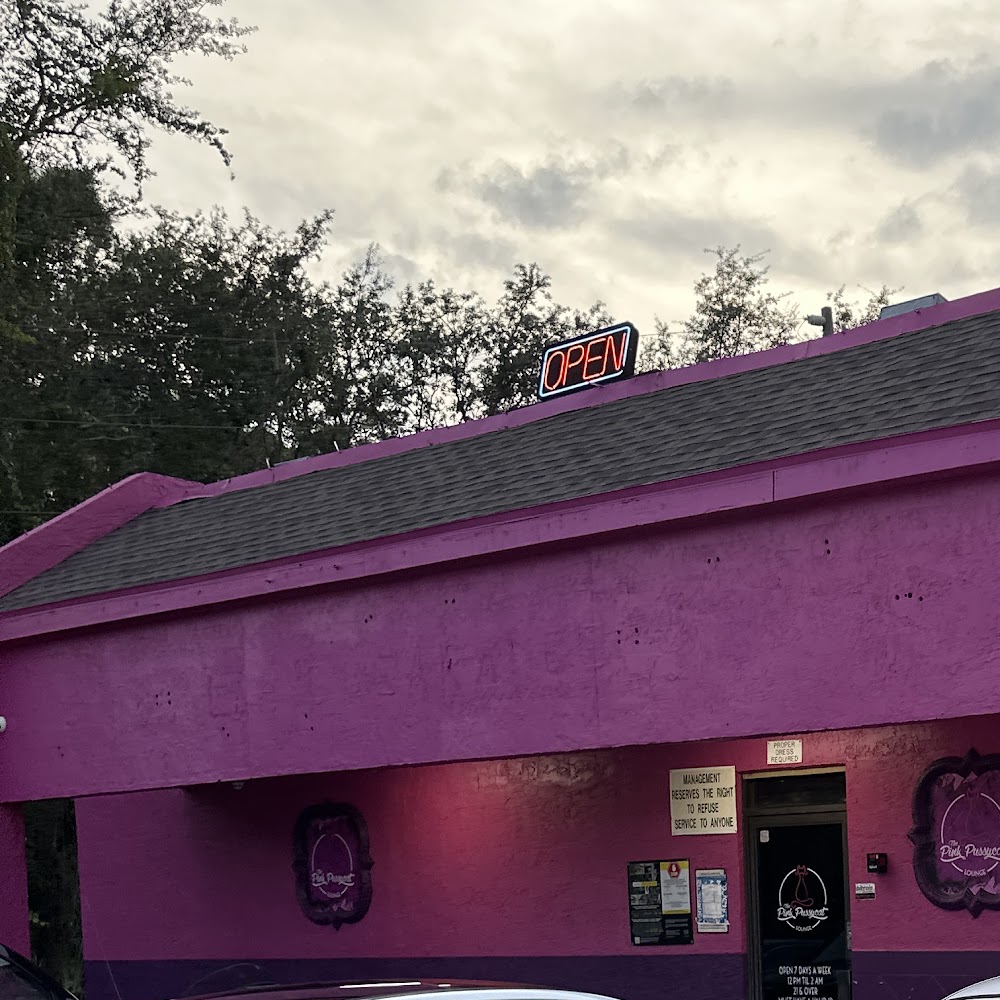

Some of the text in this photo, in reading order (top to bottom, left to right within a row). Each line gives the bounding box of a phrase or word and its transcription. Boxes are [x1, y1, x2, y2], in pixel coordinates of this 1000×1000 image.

[545, 333, 626, 390] OPEN
[773, 741, 796, 749] PROPER
[775, 748, 794, 756] DRESS
[770, 755, 799, 763] REQUIRED
[683, 773, 721, 784] MANAGEMENT
[672, 787, 734, 800] RESERVES THE RIGHT
[687, 803, 719, 814] TO REFUSE
[674, 816, 734, 829] SERVICE TO ANYONE
[940, 845, 966, 862] Pink
[778, 966, 793, 975] OPEN
[798, 965, 812, 975] DAYS
[816, 965, 832, 975] WEEK
[787, 976, 792, 985] 12
[793, 976, 801, 985] PM
[801, 976, 810, 985] TIL
[815, 976, 824, 985] AM
[793, 986, 799, 995] 21
[803, 986, 819, 995] OVER
